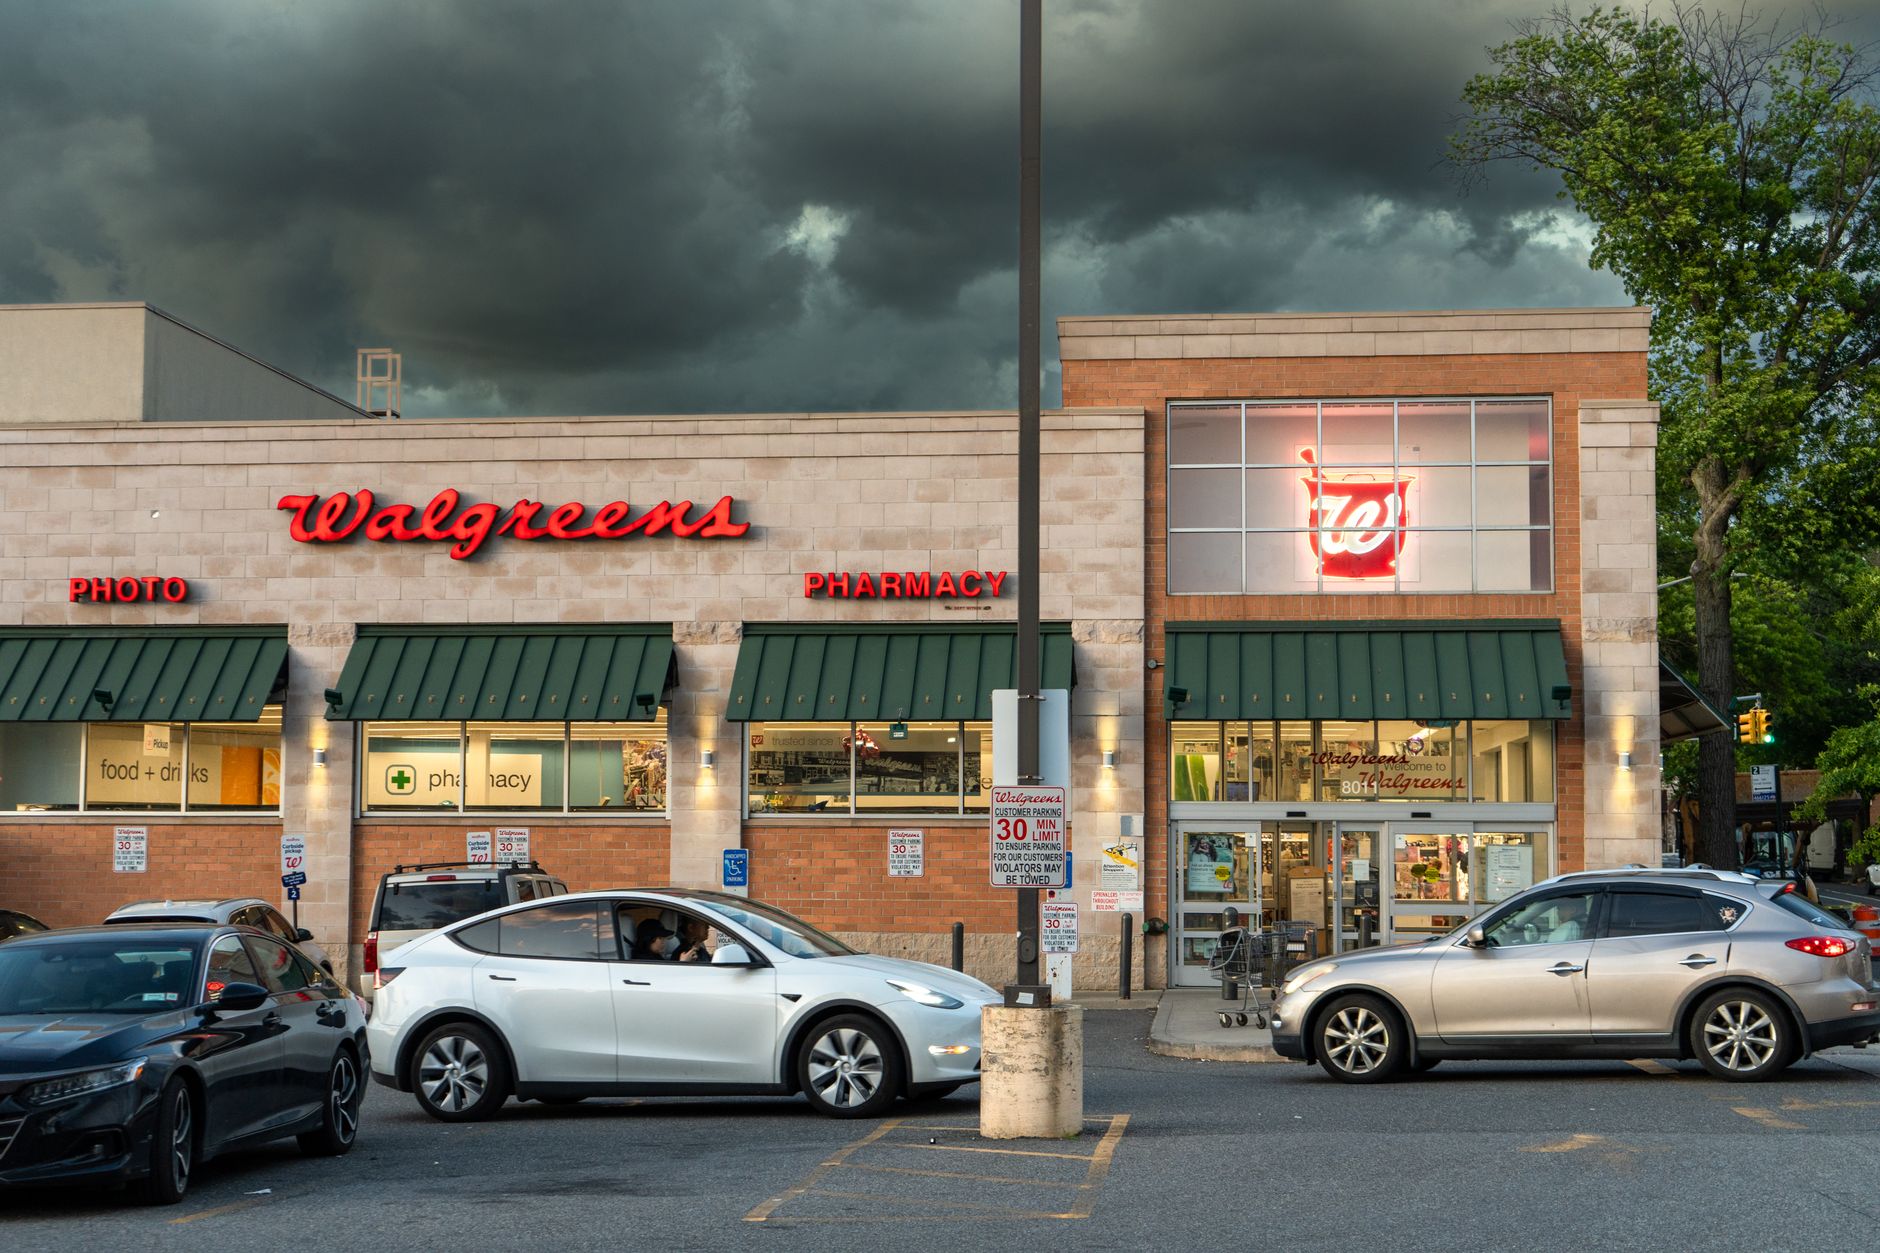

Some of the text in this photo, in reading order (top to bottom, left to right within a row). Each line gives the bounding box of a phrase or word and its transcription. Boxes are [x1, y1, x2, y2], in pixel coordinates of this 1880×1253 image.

[277, 488, 751, 561] Walgreens
[69, 577, 188, 602] PHOTO
[804, 570, 1008, 599] PHARMACY
[153, 739, 168, 751] Pickup
[772, 737, 805, 746] trusted
[807, 737, 833, 746] since
[1308, 752, 1410, 769] Walgreens
[101, 759, 139, 780] food
[160, 762, 208, 783] driks
[1384, 763, 1446, 771] Welcome to
[429, 769, 531, 792] phacy
[1358, 771, 1466, 794] Walgreens
[1341, 780, 1377, 794] 8011
[995, 791, 1062, 807] Walgreens
[995, 808, 1062, 817] CUSTOMER PARKING
[1036, 819, 1056, 829] MIN
[996, 818, 1027, 841] 30
[1032, 831, 1061, 841] LIMIT
[118, 842, 131, 850] 30
[500, 843, 513, 851] 30
[892, 845, 906, 854] 30
[995, 842, 1062, 850] TO ENSURE PARKING
[994, 853, 1006, 862] FOR
[1007, 853, 1022, 862] OUR
[1023, 853, 1063, 862] CUSTOMERS
[994, 863, 1062, 873] VIOLATORS MAY
[1005, 875, 1050, 885] BE TOWED
[1045, 920, 1060, 929] 30
